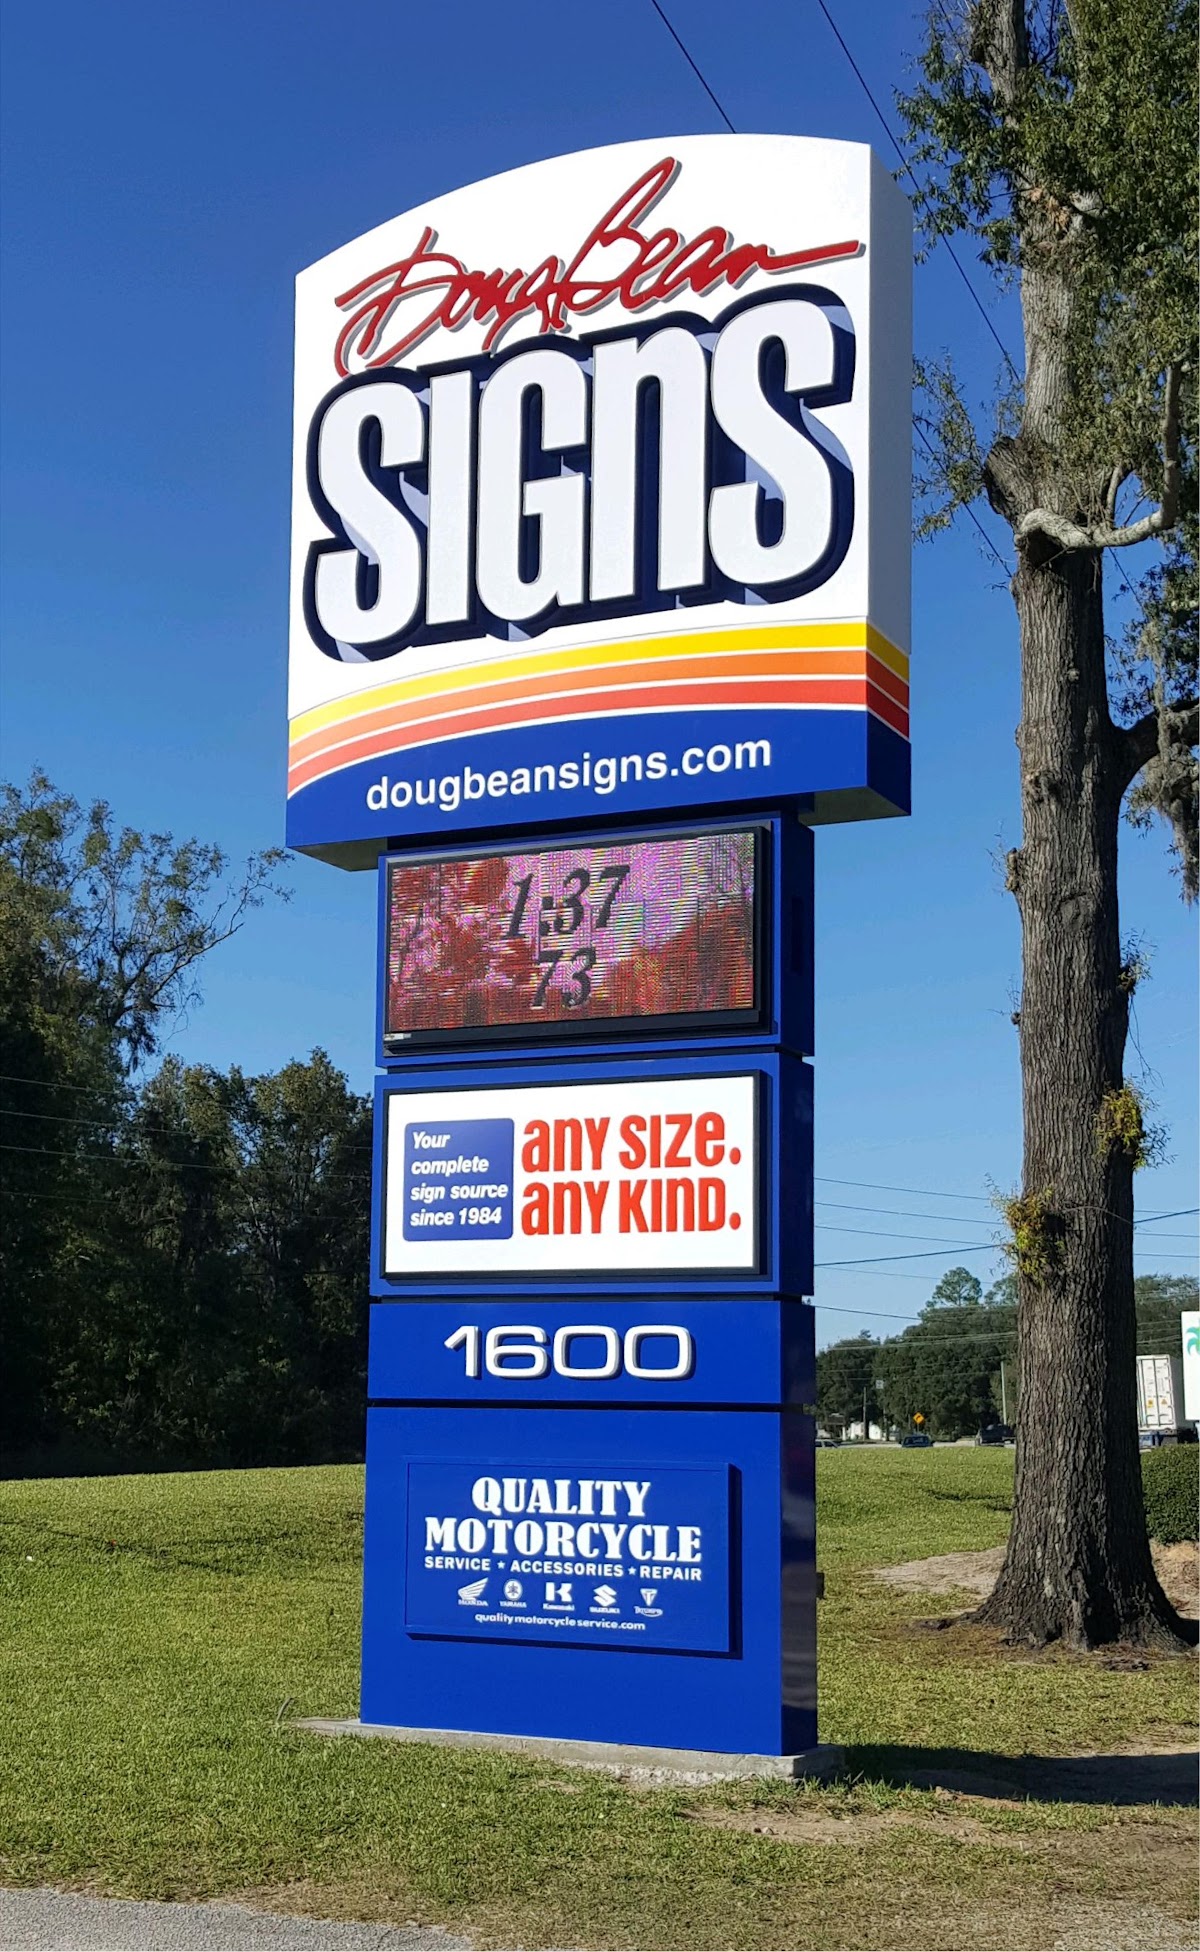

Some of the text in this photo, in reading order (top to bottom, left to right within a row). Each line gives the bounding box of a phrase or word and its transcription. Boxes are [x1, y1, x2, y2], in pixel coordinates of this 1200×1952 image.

[334, 156, 866, 378] Doug Bean
[366, 739, 771, 812] dougbeansigns.com
[506, 864, 630, 939] 1:37
[531, 946, 597, 1010] 73
[412, 1131, 450, 1150] Your
[411, 1155, 489, 1177] complete
[410, 1183, 508, 1204] sign source
[410, 1206, 502, 1227] since 1984
[444, 1325, 693, 1380] 1600
[471, 1476, 651, 1517] QUALITY
[425, 1517, 702, 1563] MOTORCYCLE
[424, 1556, 702, 1581] SERVICE ACCESSORIES REPAIR
